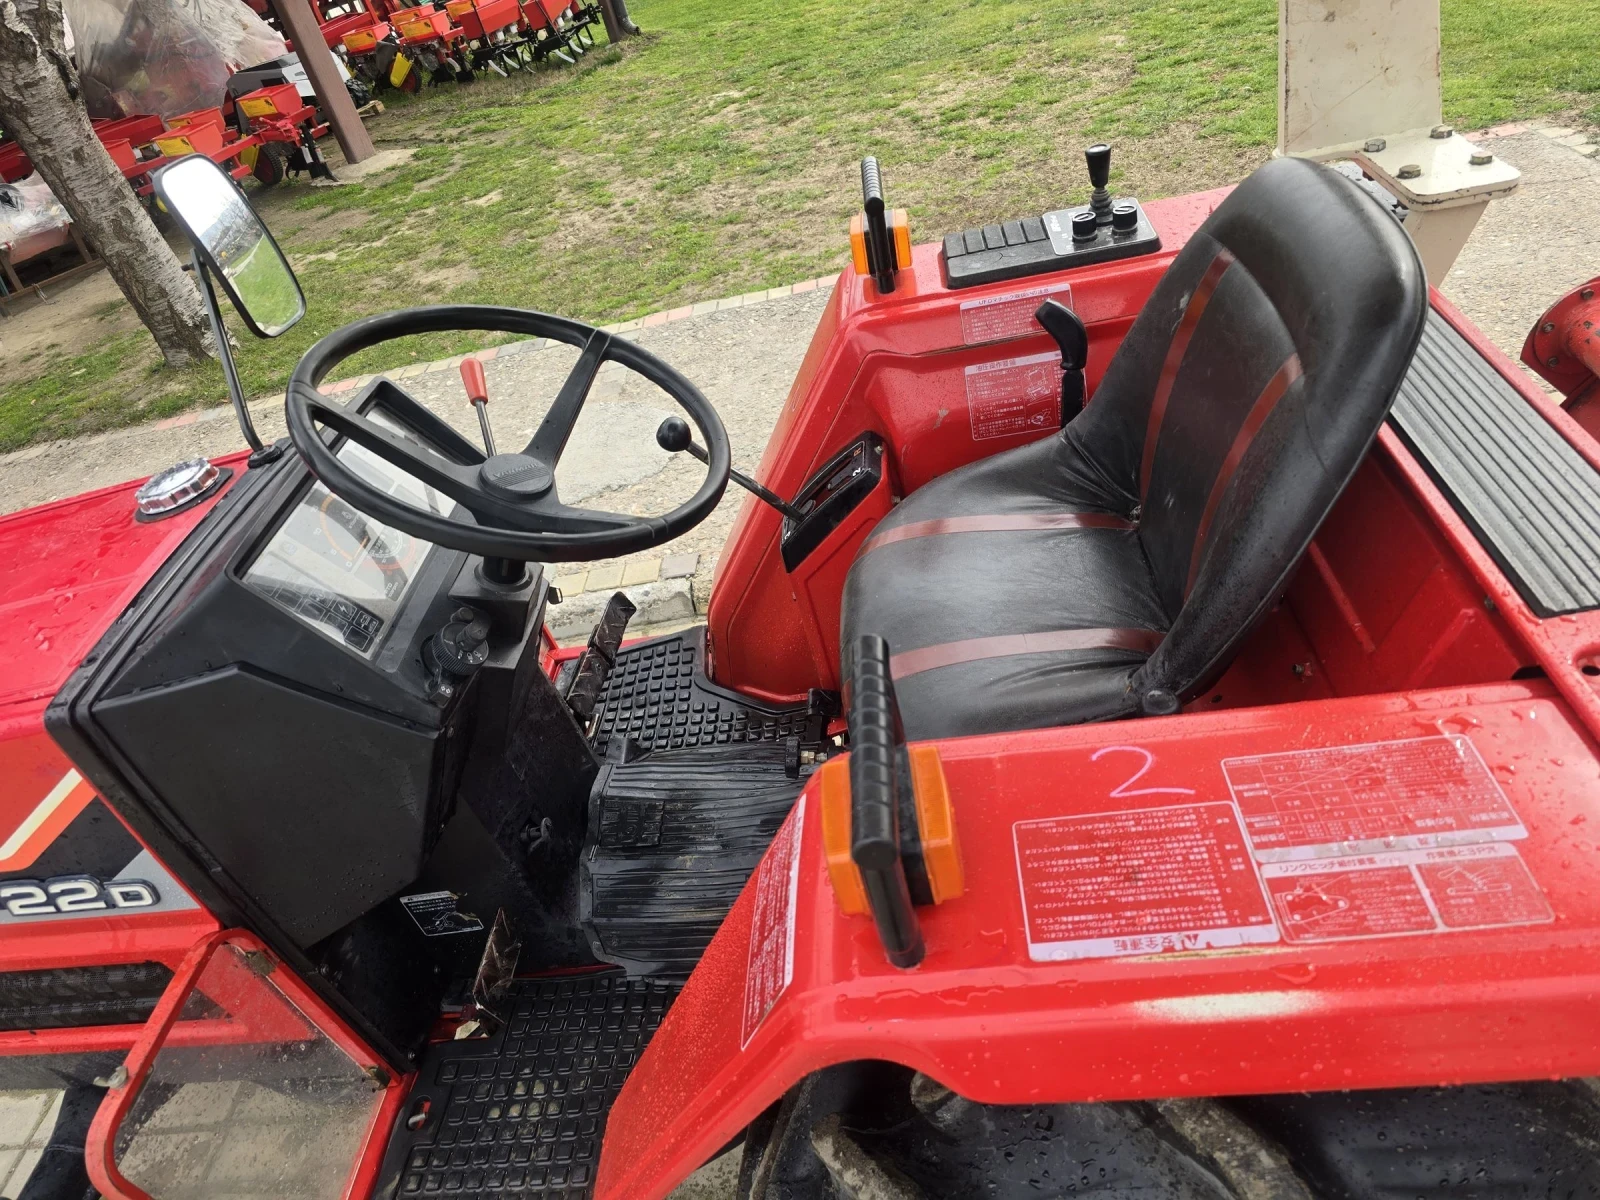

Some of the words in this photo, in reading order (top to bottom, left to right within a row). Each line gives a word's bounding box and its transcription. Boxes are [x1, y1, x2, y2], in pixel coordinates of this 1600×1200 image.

[1091, 745, 1196, 798] 2
[1113, 932, 1177, 953] 安全運転
